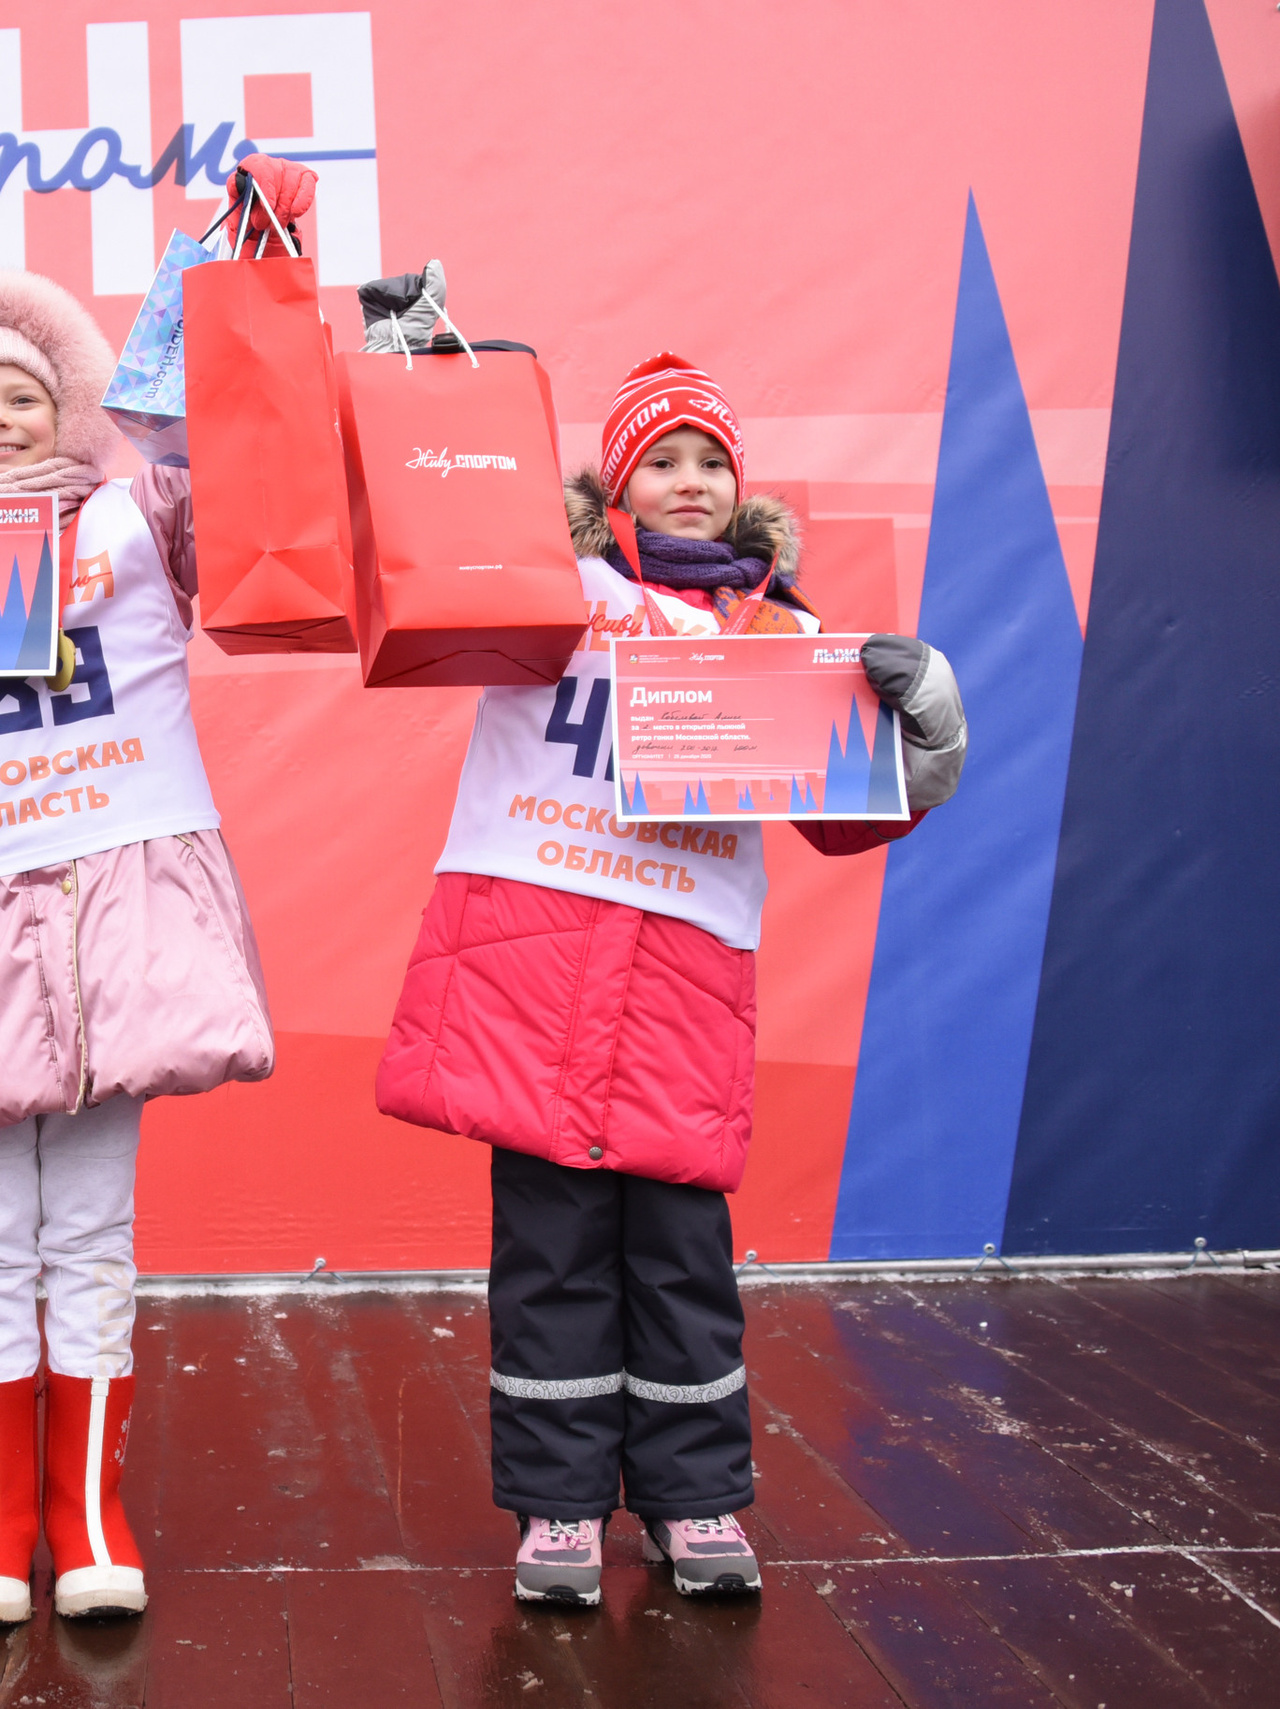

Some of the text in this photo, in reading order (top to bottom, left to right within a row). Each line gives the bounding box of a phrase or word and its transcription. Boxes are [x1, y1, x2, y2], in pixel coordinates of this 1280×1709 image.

[405, 446, 518, 478] Живу СПОРТОМ
[630, 687, 713, 707] Диплом
[631, 734, 652, 742] ретро
[675, 733, 719, 741] Московской
[681, 723, 715, 732] открытой
[508, 794, 738, 861] МОСКОВСКАЯ
[536, 840, 697, 894] ОБЛАСТЬ
